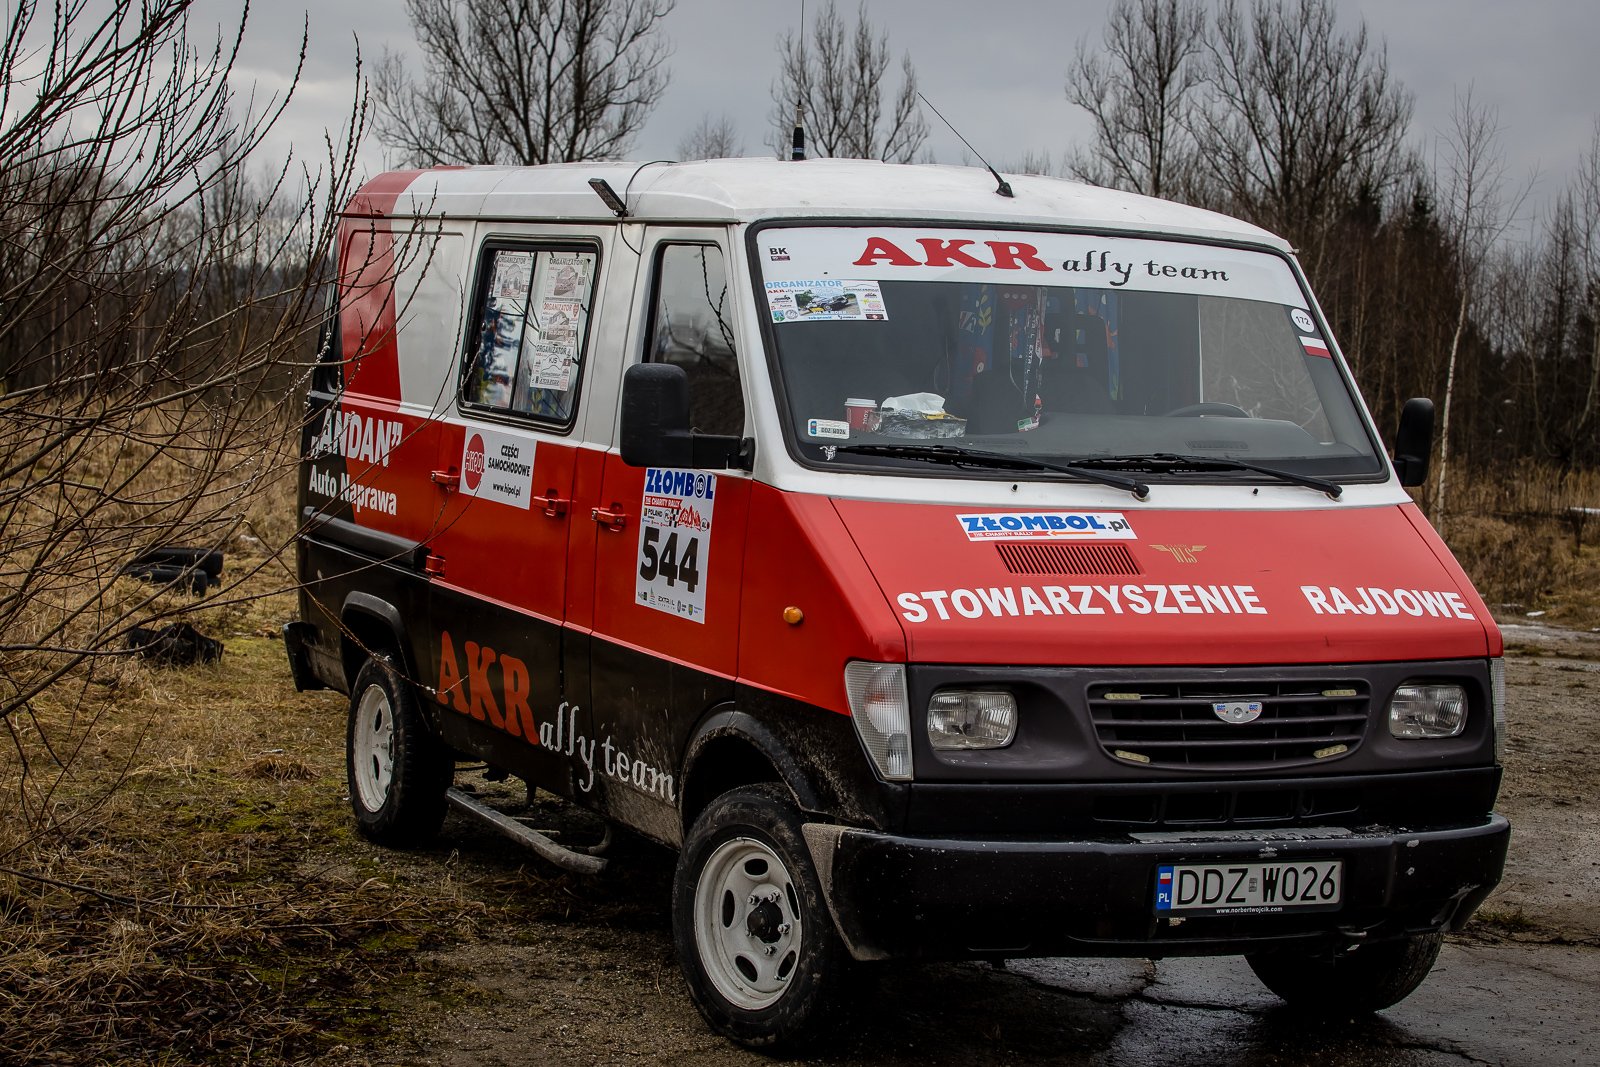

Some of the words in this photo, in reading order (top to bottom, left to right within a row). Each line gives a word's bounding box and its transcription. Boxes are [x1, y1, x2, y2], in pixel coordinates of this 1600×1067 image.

[770, 247, 788, 255] BK
[853, 236, 1053, 272] AKR
[1062, 250, 1133, 287] ally
[1147, 259, 1230, 282] team
[765, 280, 843, 289] ORGANIZATOR
[488, 457, 530, 478] SAMOCHODOWE
[309, 464, 337, 498] Auto
[340, 472, 397, 515] Naprawa
[493, 483, 521, 498] www.hipol.pl
[640, 526, 699, 593] 544
[897, 584, 1267, 623] STOWARZYSZENIE
[1300, 585, 1475, 622] RAJDOWE
[436, 630, 540, 746] AKR
[539, 701, 595, 793] ally
[601, 735, 676, 802] team
[1158, 893, 1170, 903] PL
[1177, 868, 1249, 906] DDZ
[1262, 865, 1337, 903] W026
[1216, 906, 1283, 914] www.norbertwojcik.com
